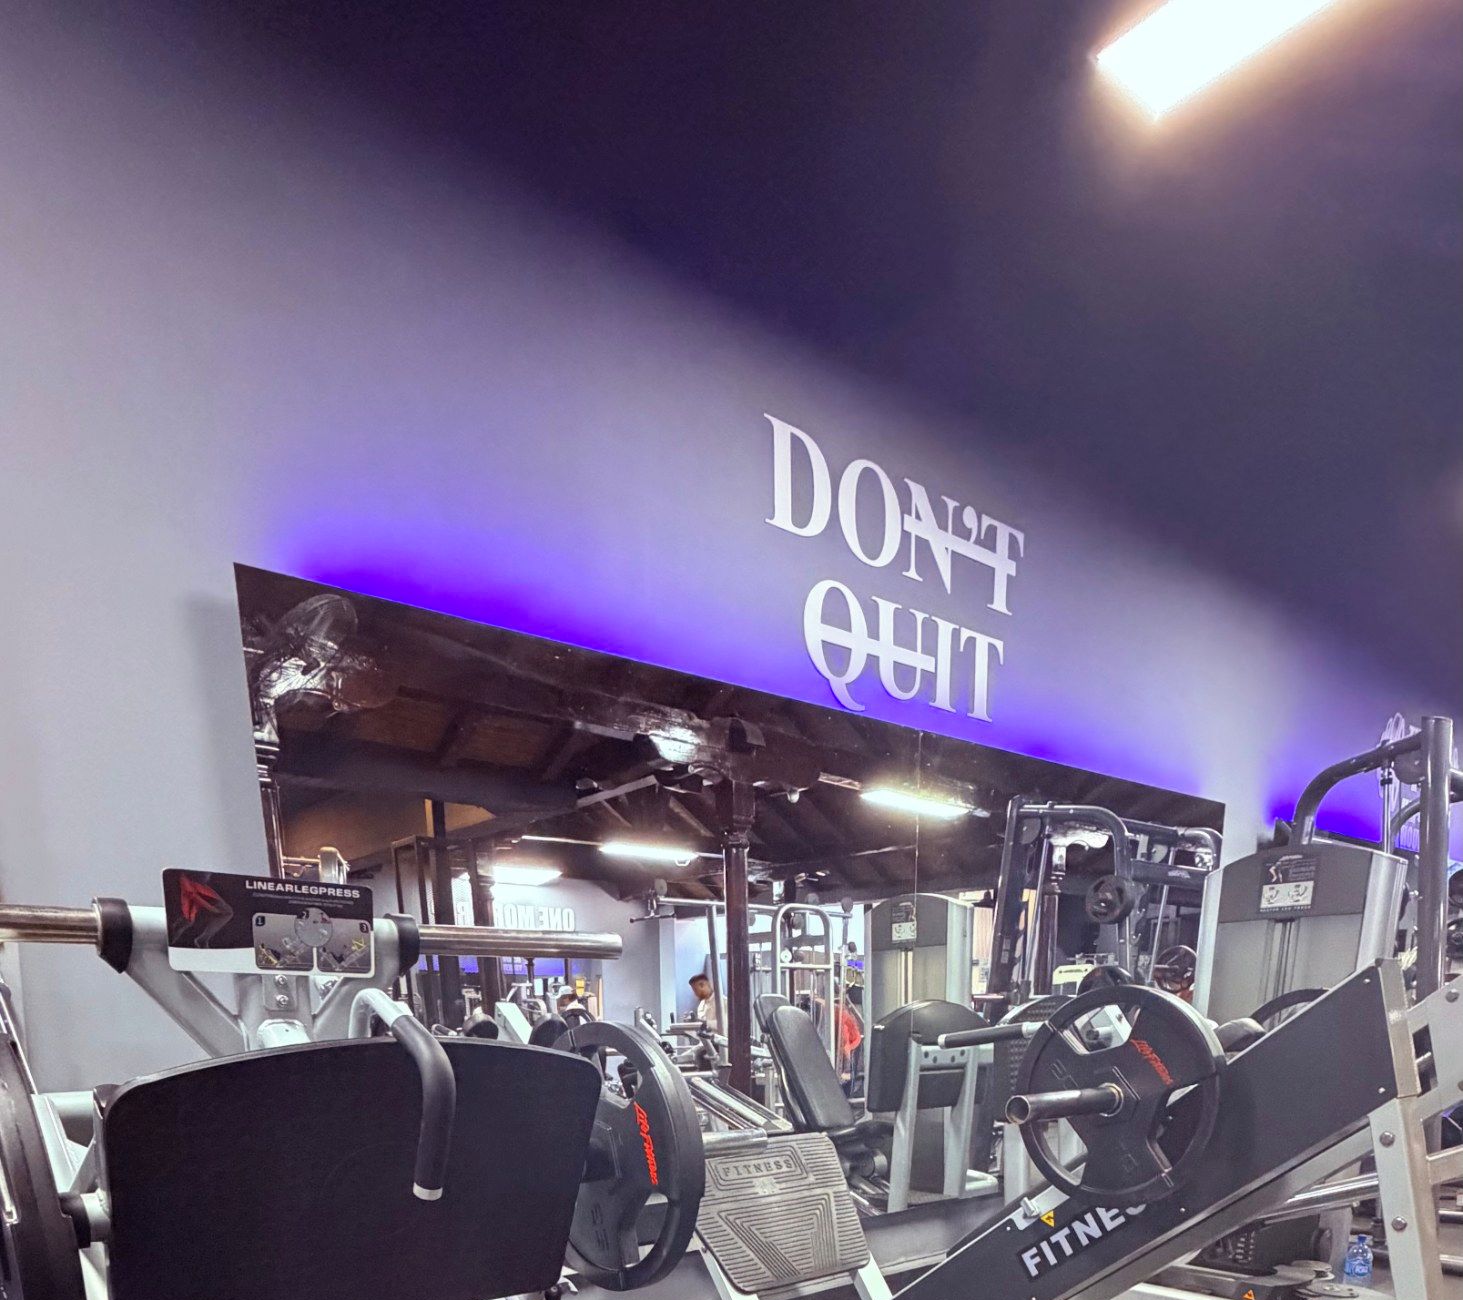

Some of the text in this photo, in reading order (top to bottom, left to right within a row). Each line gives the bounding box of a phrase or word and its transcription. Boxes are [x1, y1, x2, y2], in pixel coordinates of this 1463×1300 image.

[763, 412, 1025, 616] DON'T
[803, 579, 1004, 723] QUIT
[722, 1158, 794, 1177] FITNESS
